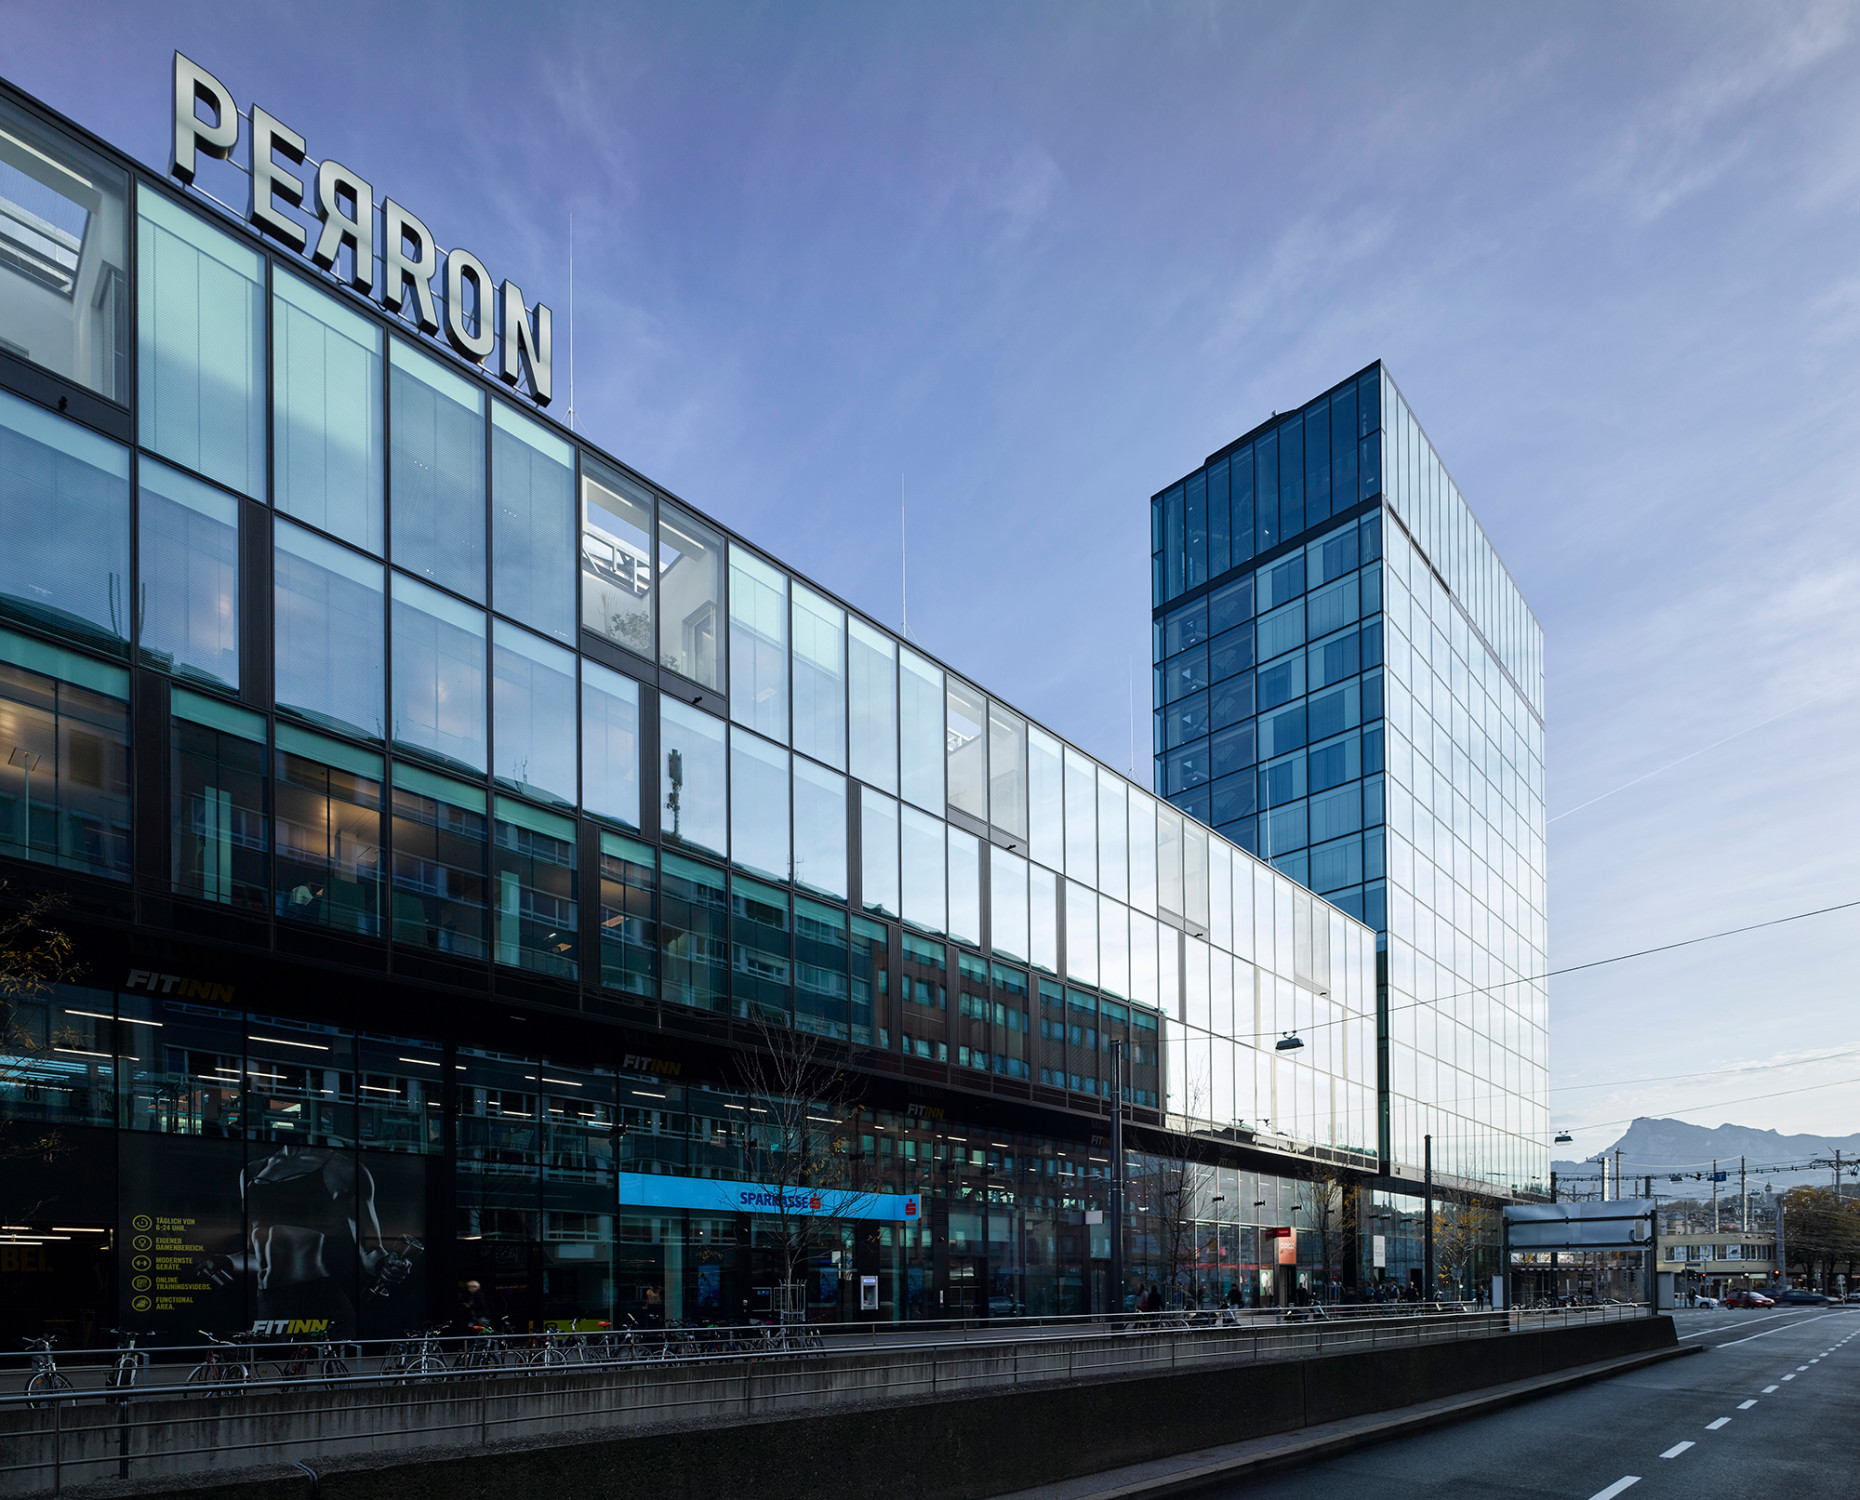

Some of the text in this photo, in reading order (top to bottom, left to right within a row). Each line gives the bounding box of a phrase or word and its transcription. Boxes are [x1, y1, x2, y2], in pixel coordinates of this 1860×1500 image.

[125, 968, 236, 1004] FITINN
[622, 1053, 683, 1077] FITINN
[155, 1216, 182, 1225] TÄGLICH
[155, 1256, 193, 1264] MODERNSTE
[155, 1296, 194, 1304] FUNCTIONAL
[251, 1319, 329, 1335] FITINN
